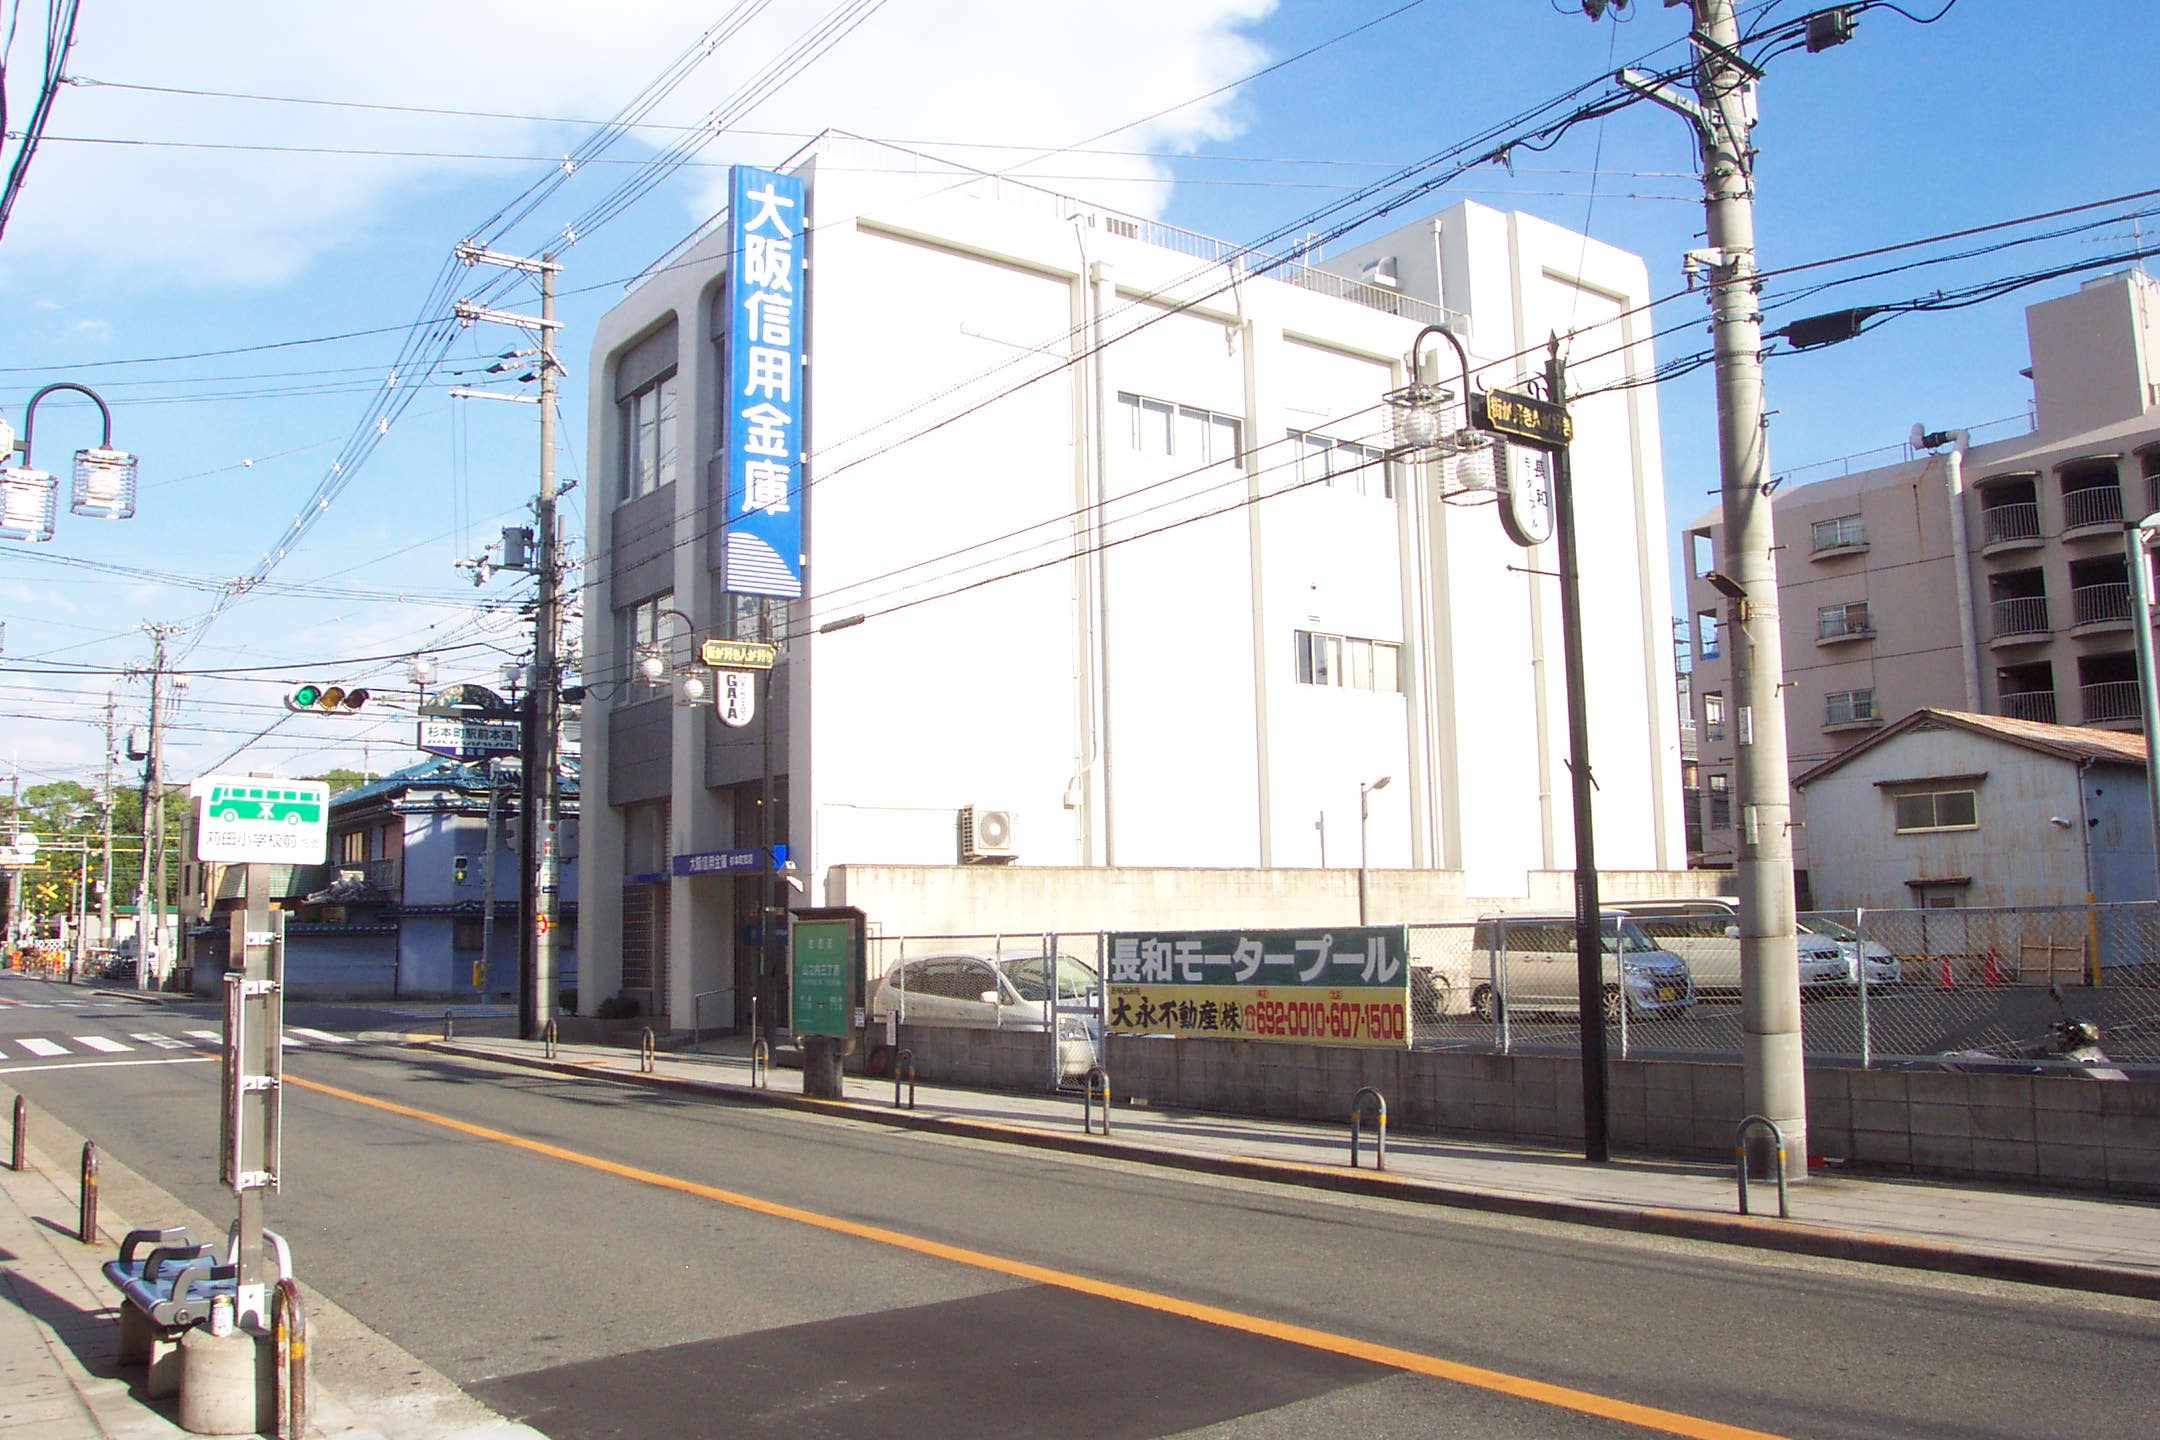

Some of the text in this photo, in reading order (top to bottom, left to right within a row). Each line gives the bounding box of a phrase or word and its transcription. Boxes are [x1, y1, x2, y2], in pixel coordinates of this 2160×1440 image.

[740, 182, 795, 517] 大阪信用金庫
[726, 674, 738, 719] GAIA
[1111, 934, 1401, 983] 長和モータープール
[1111, 995, 1244, 1032] 大永不動産(株)
